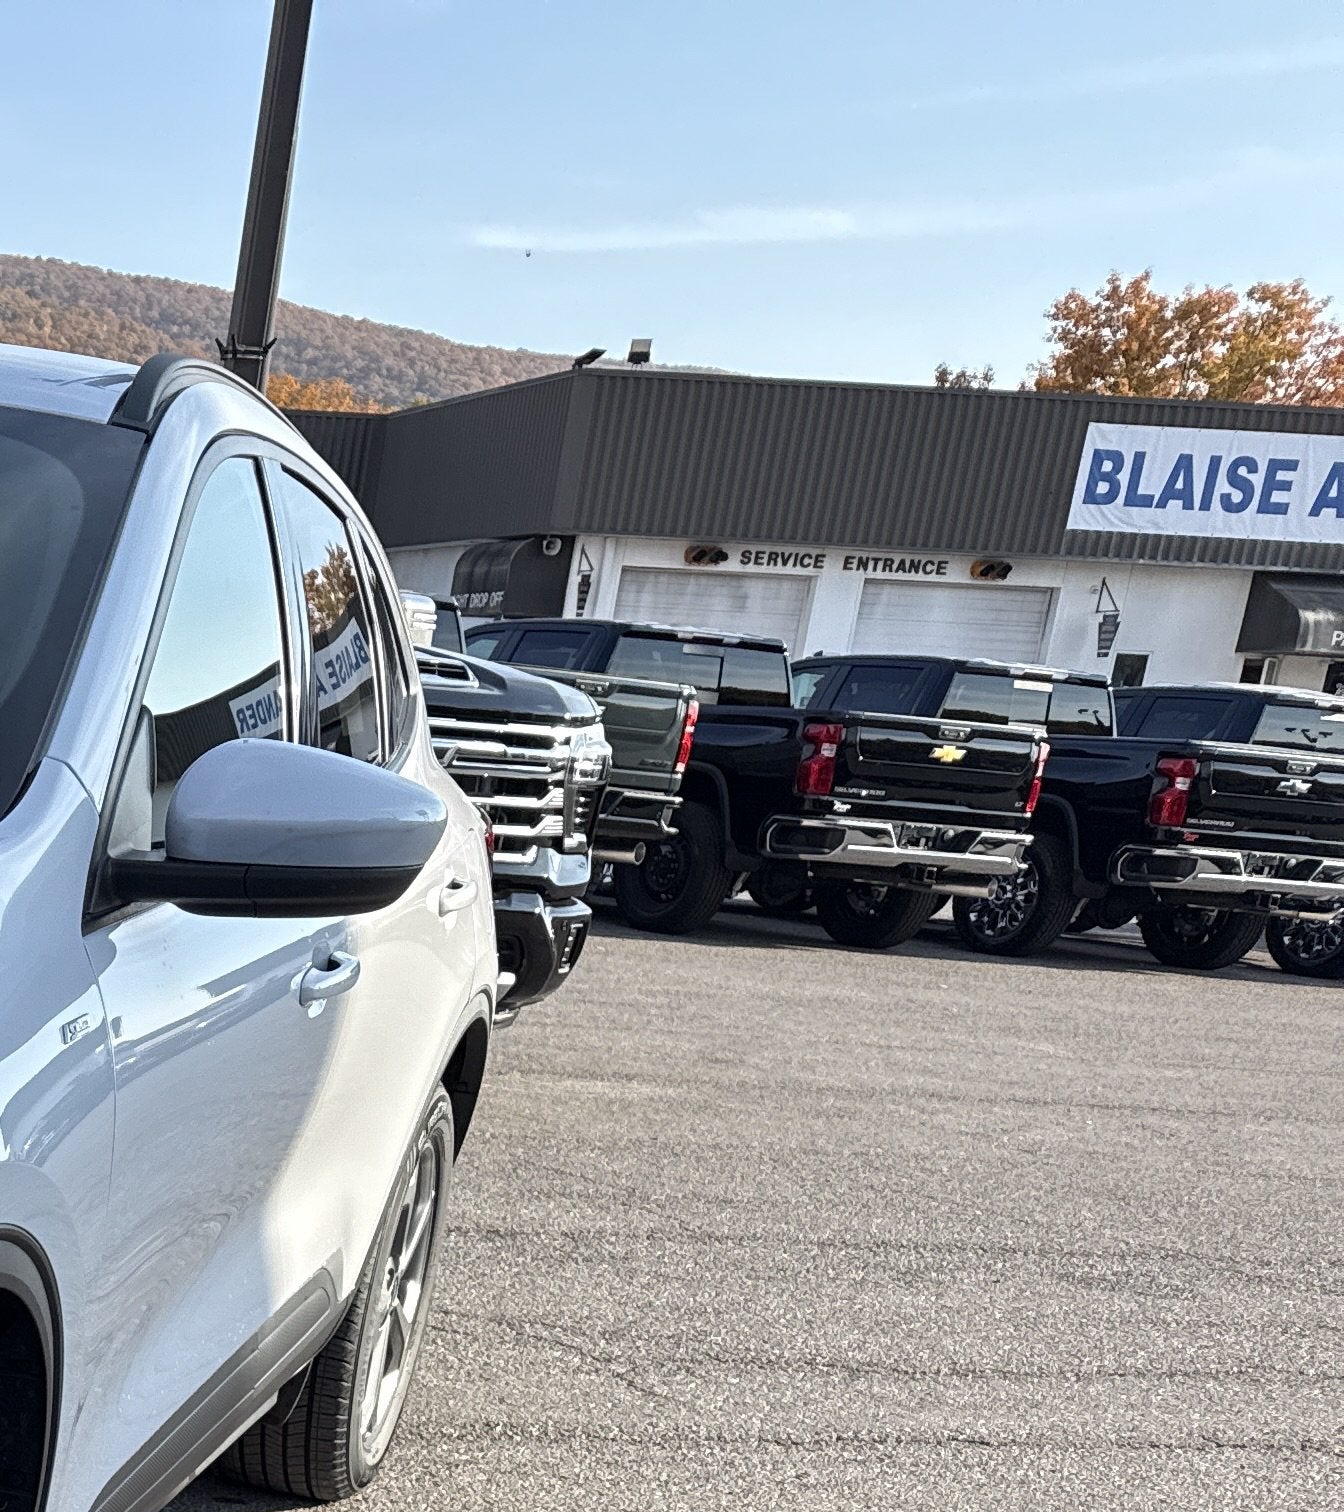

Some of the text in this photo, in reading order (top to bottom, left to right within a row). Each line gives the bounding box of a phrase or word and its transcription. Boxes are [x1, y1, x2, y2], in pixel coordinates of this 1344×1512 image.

[1081, 447, 1301, 515] BLAISE
[739, 549, 950, 576] SERVICE ENTRANCE
[469, 591, 489, 608] DROP
[489, 590, 505, 606] OFF
